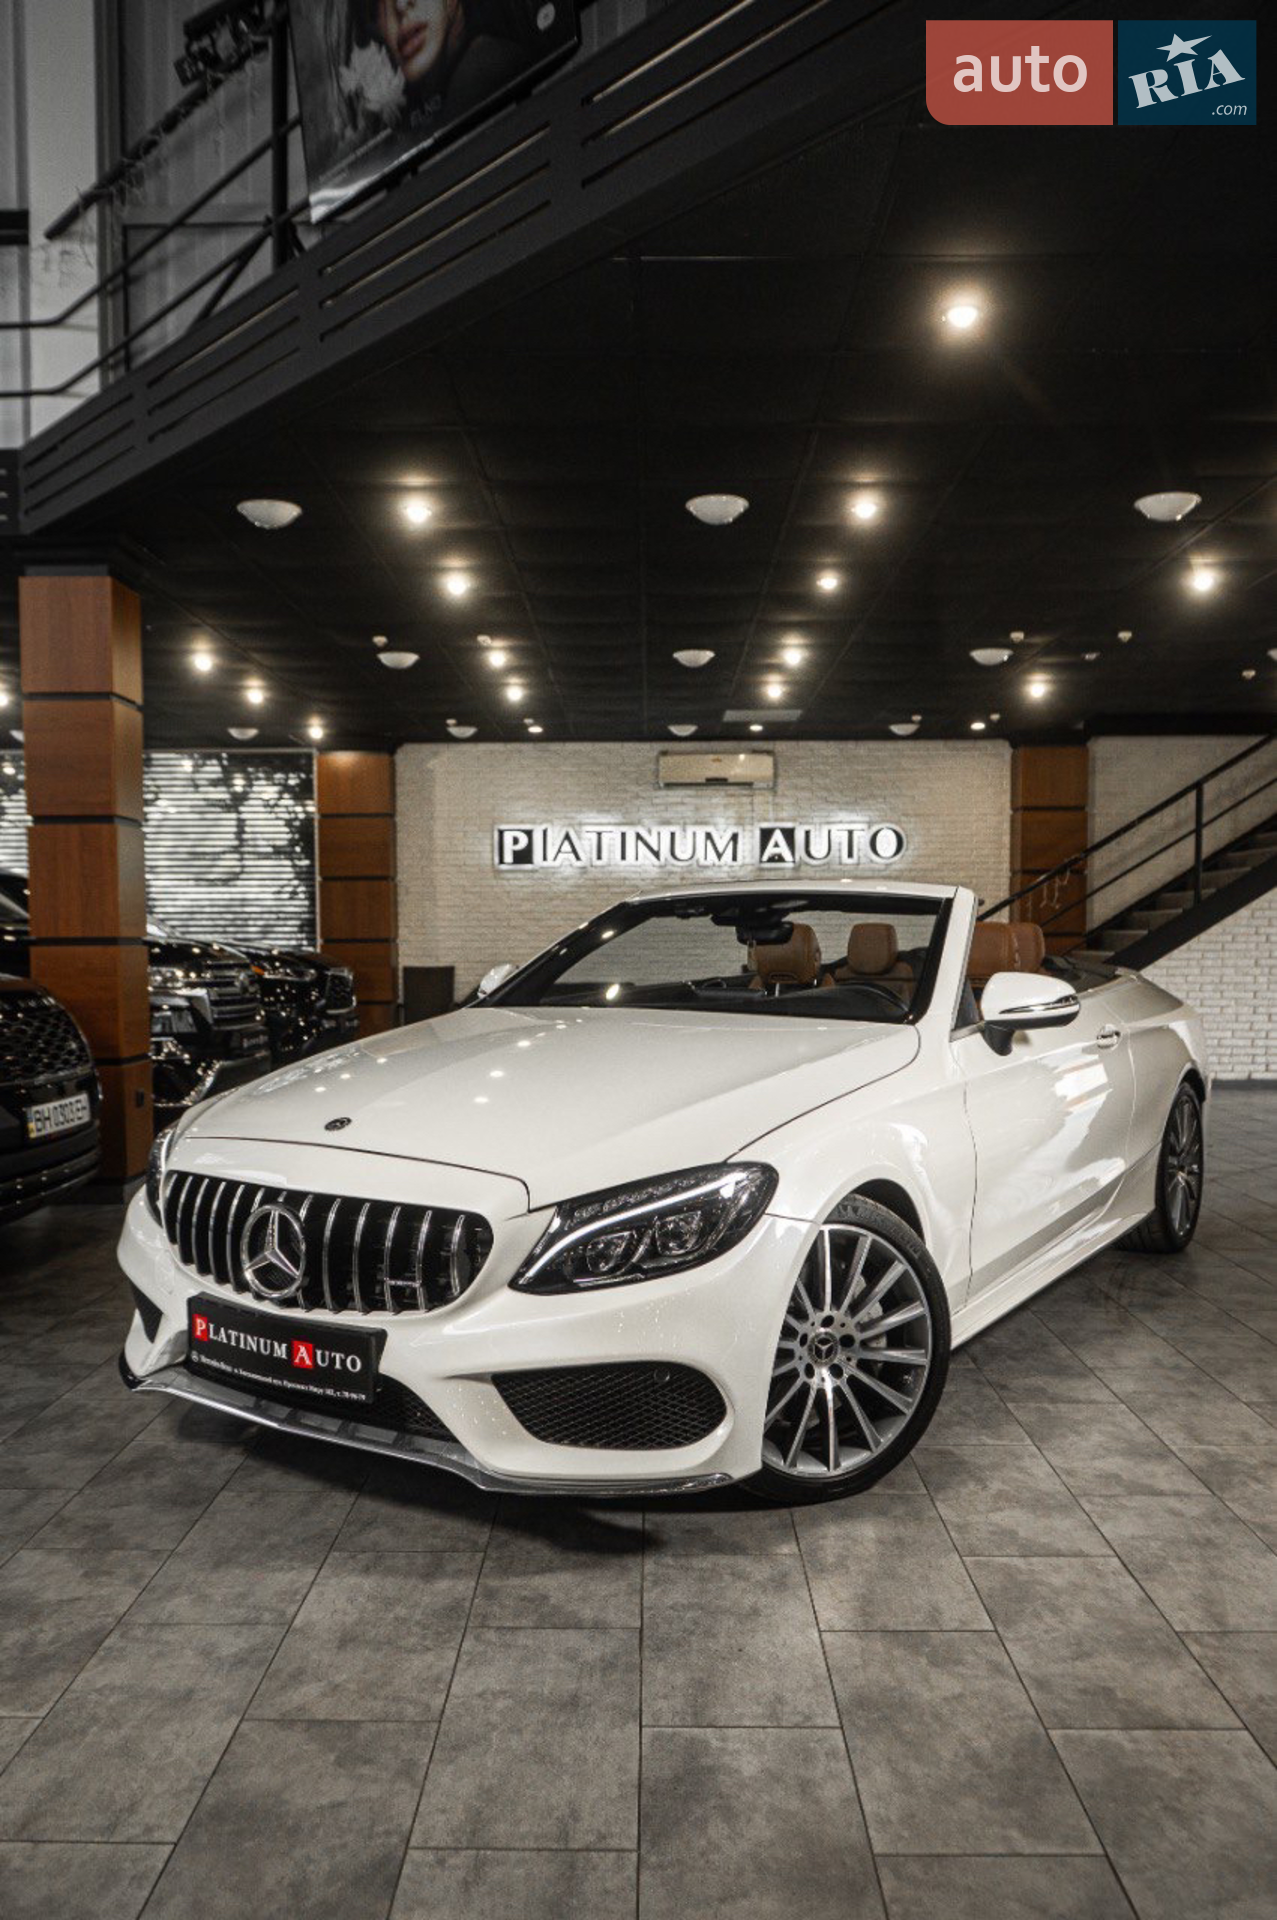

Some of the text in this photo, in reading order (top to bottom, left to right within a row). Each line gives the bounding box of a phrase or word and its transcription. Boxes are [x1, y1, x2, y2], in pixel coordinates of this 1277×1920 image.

[498, 826, 905, 866] PLATINUM AUTO
[194, 1314, 363, 1374] PLATINUM AUTO
